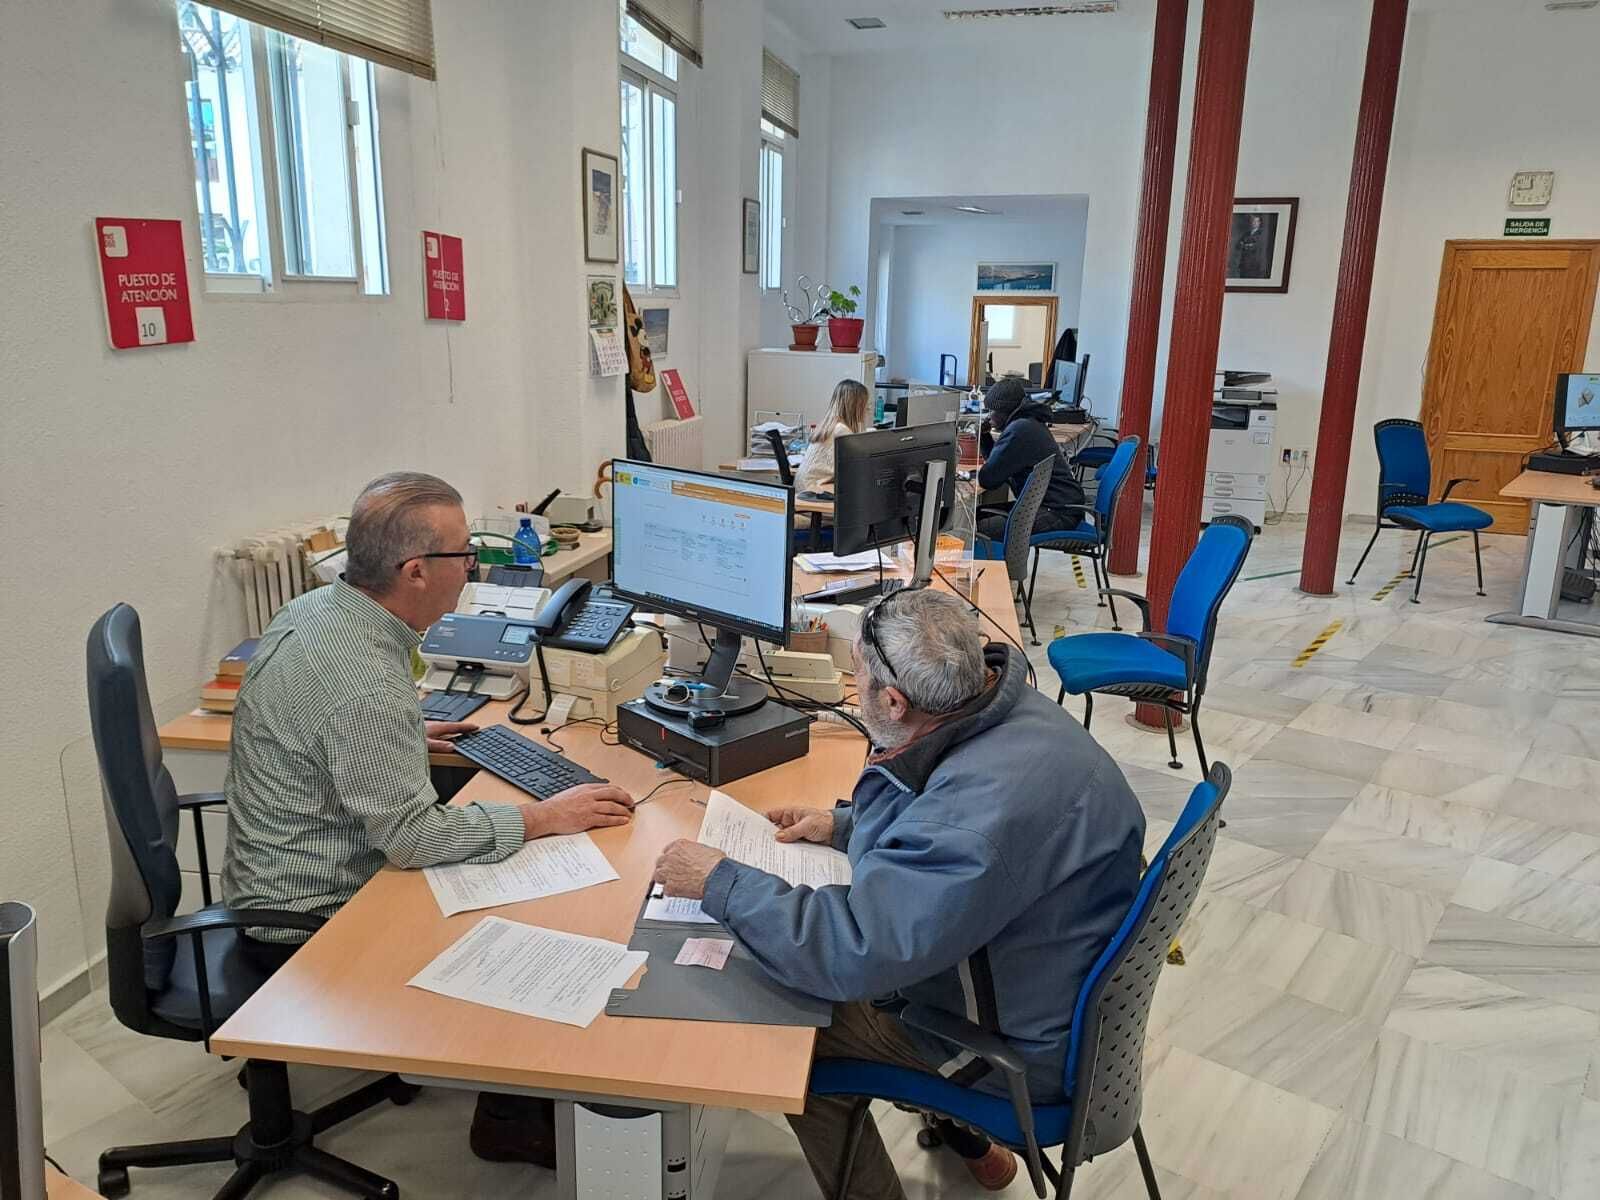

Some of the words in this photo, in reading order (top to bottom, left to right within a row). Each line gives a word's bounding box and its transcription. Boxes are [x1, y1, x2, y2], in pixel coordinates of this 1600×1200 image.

[118, 273, 160, 287] PUESTO
[161, 273, 176, 285] DE
[121, 286, 178, 303] ATENCIÓN
[141, 322, 157, 338] 10
